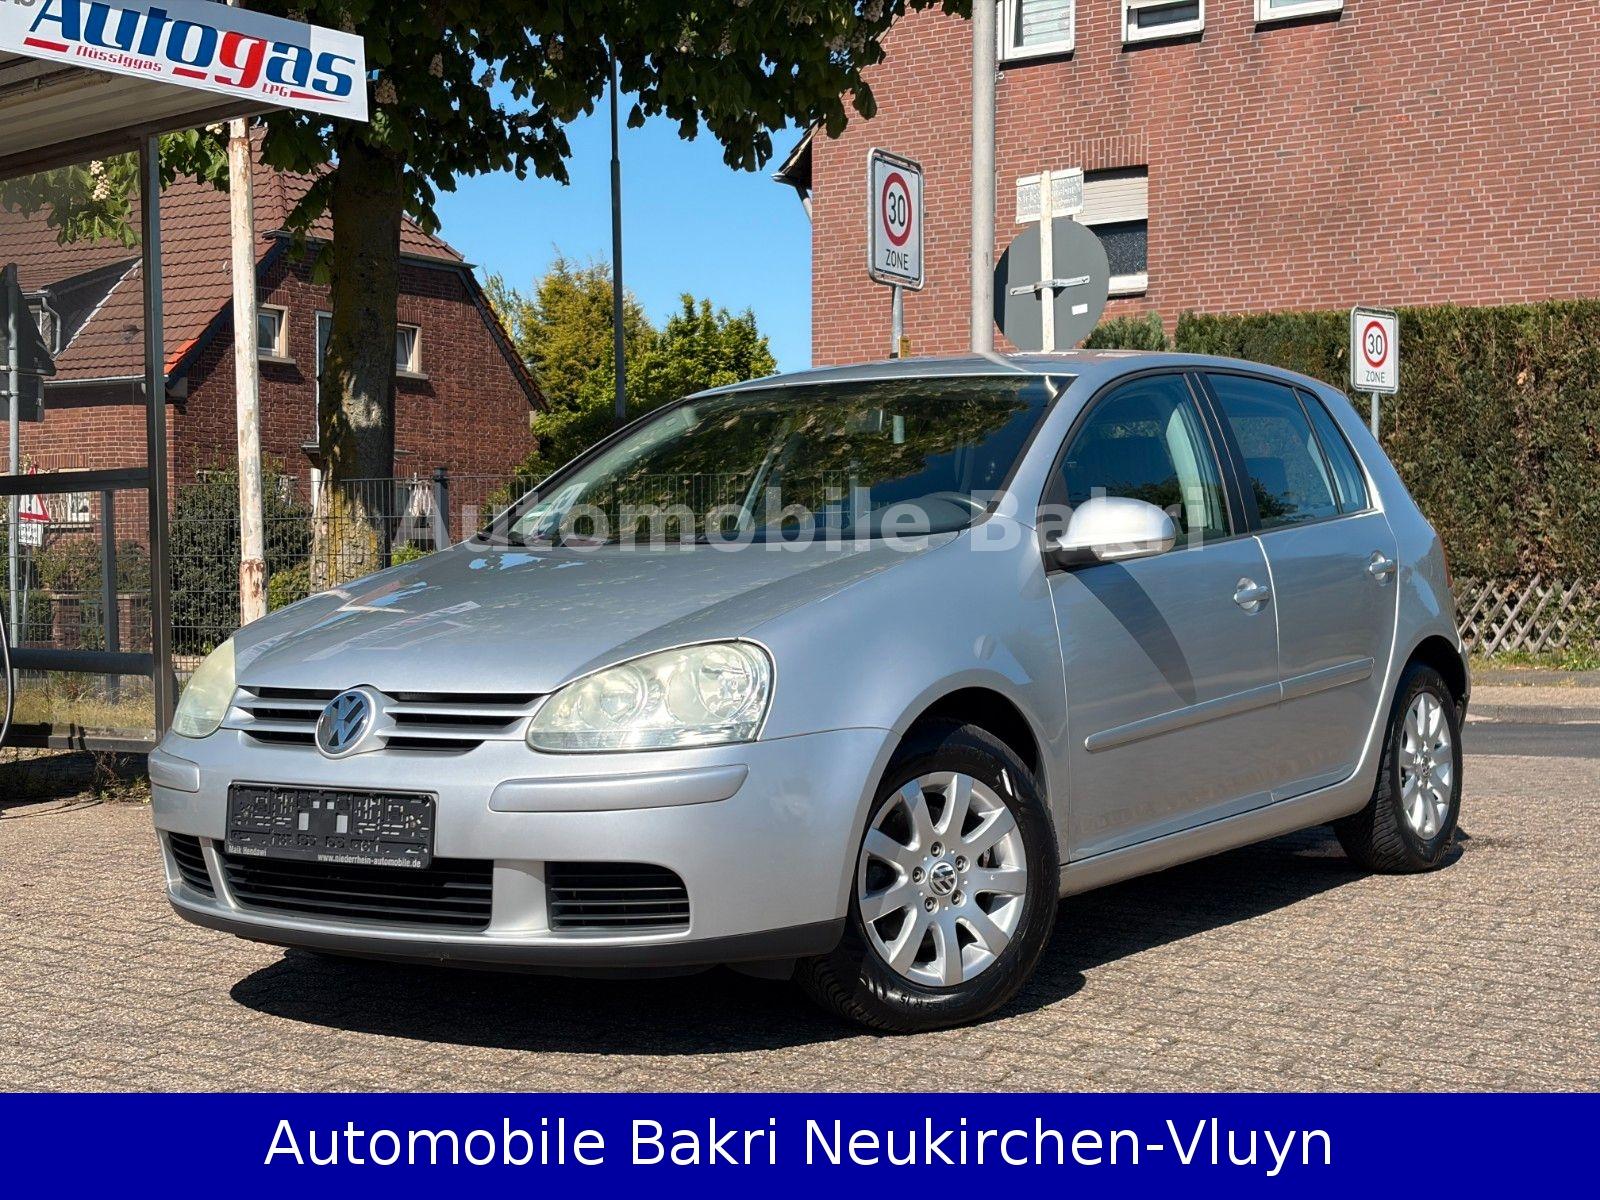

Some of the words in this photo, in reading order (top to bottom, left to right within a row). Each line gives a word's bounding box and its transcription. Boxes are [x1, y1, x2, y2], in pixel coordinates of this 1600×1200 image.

[28, 0, 356, 97] Autogas
[261, 82, 289, 98] LPG
[888, 191, 906, 228] 30
[885, 248, 909, 271] ZONE
[1367, 333, 1383, 356] 30
[1365, 370, 1386, 384] ZONE
[317, 853, 422, 868] www.niederrhein-automobile.de
